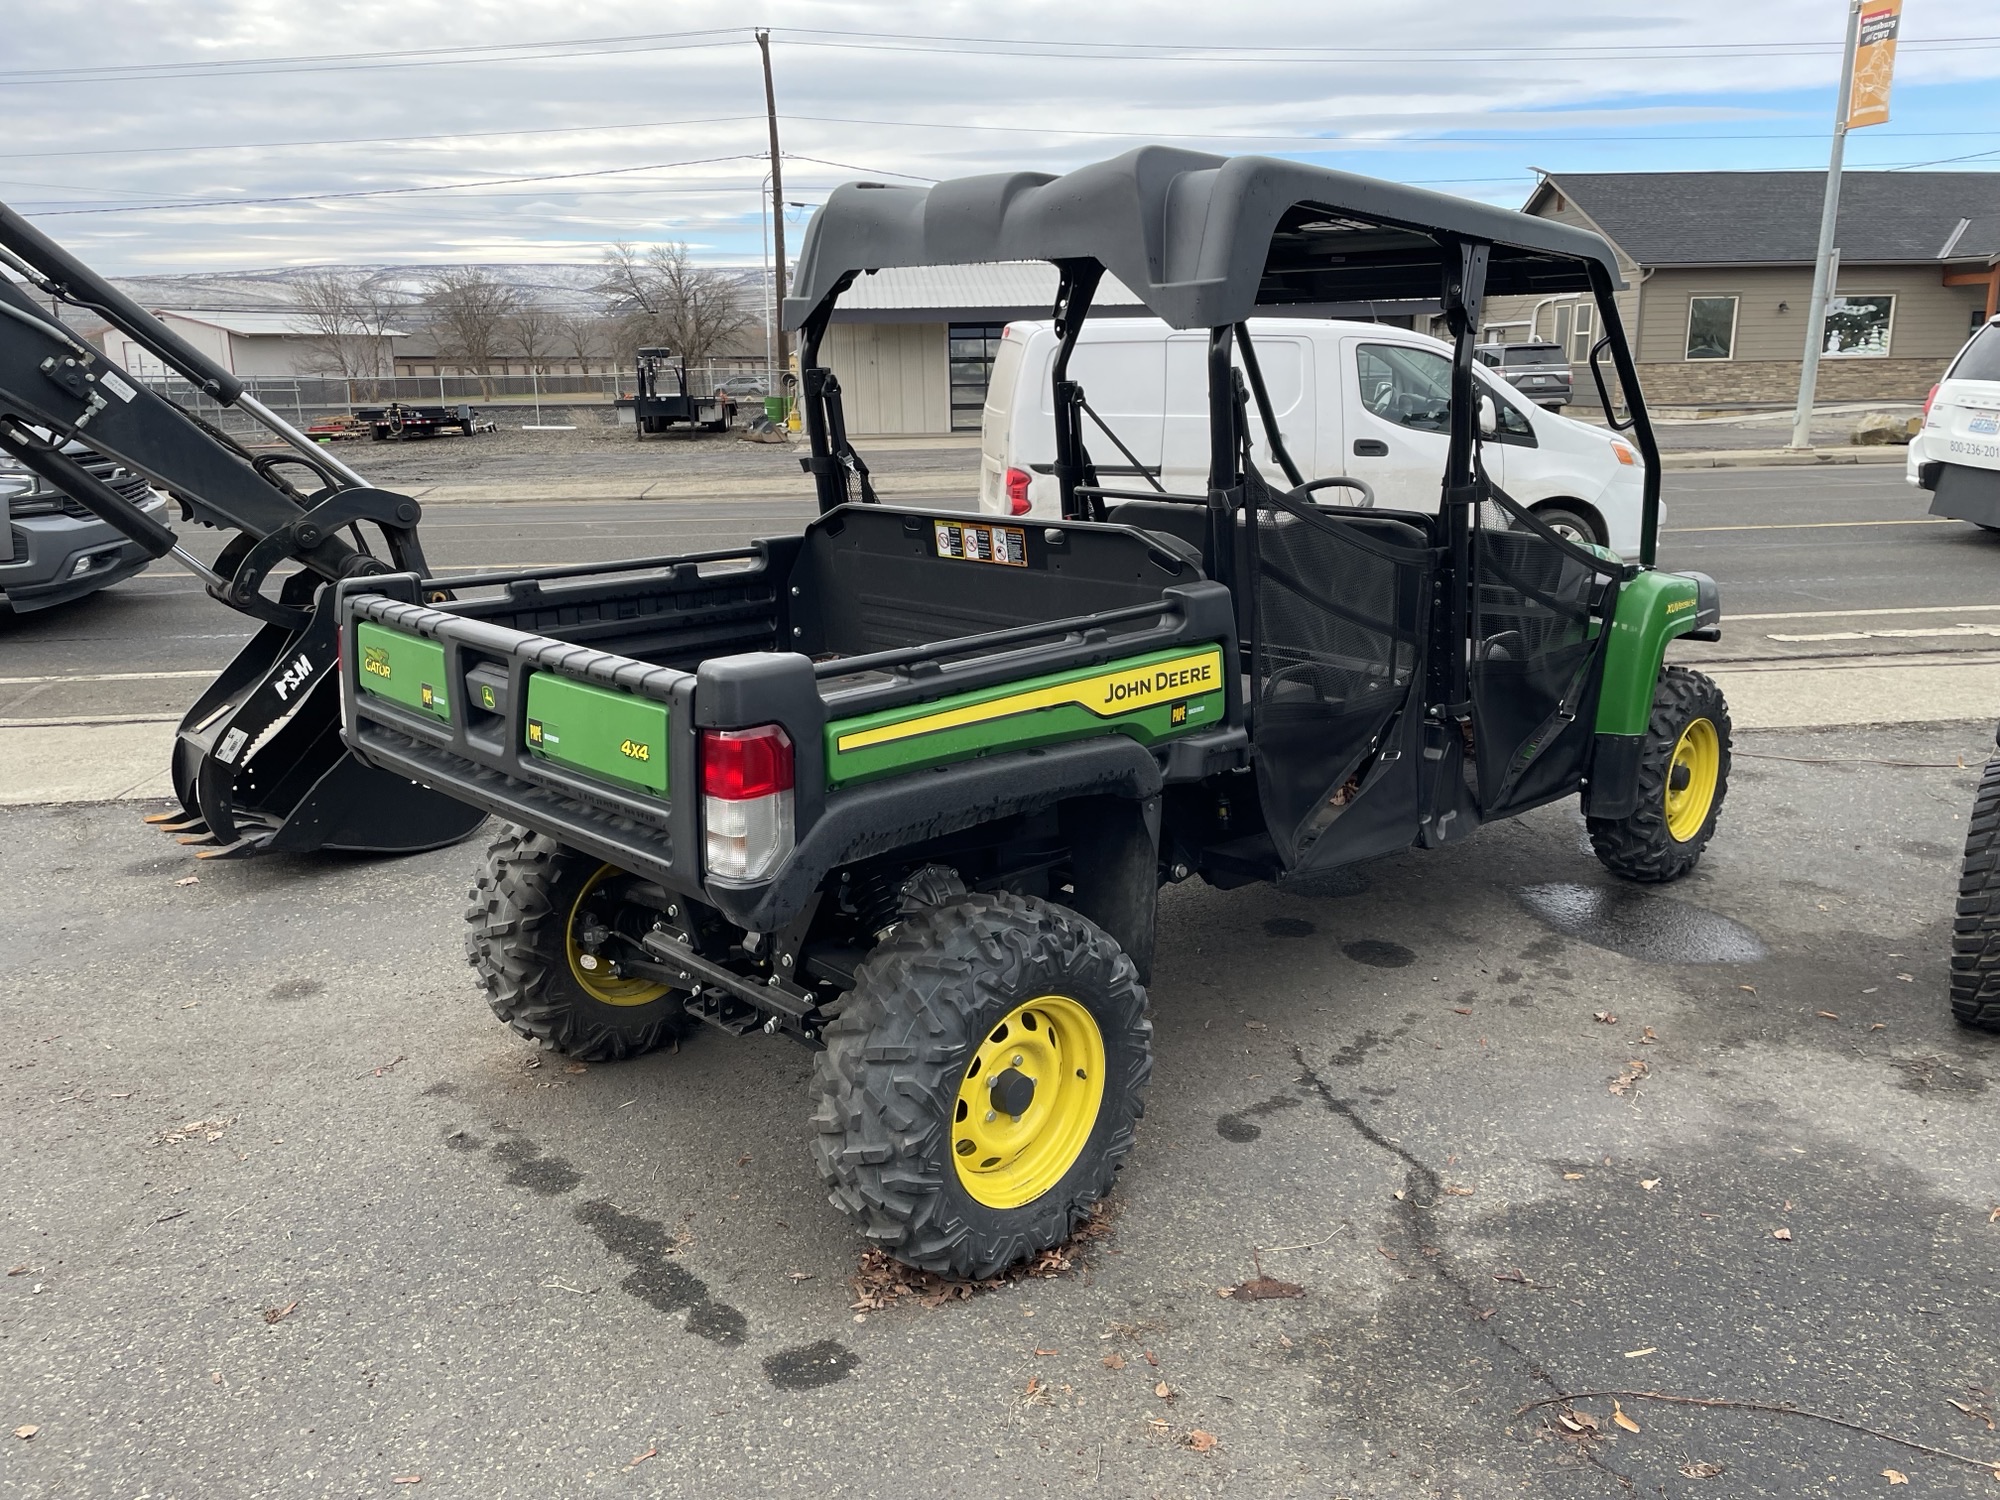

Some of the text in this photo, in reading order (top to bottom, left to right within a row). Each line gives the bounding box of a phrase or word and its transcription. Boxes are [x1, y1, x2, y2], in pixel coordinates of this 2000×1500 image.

[1862, 20, 1896, 34] Ellensburg
[1872, 30, 1890, 40] CWU
[365, 657, 391, 679] GATOR
[1104, 665, 1211, 703] JOHN DEERE
